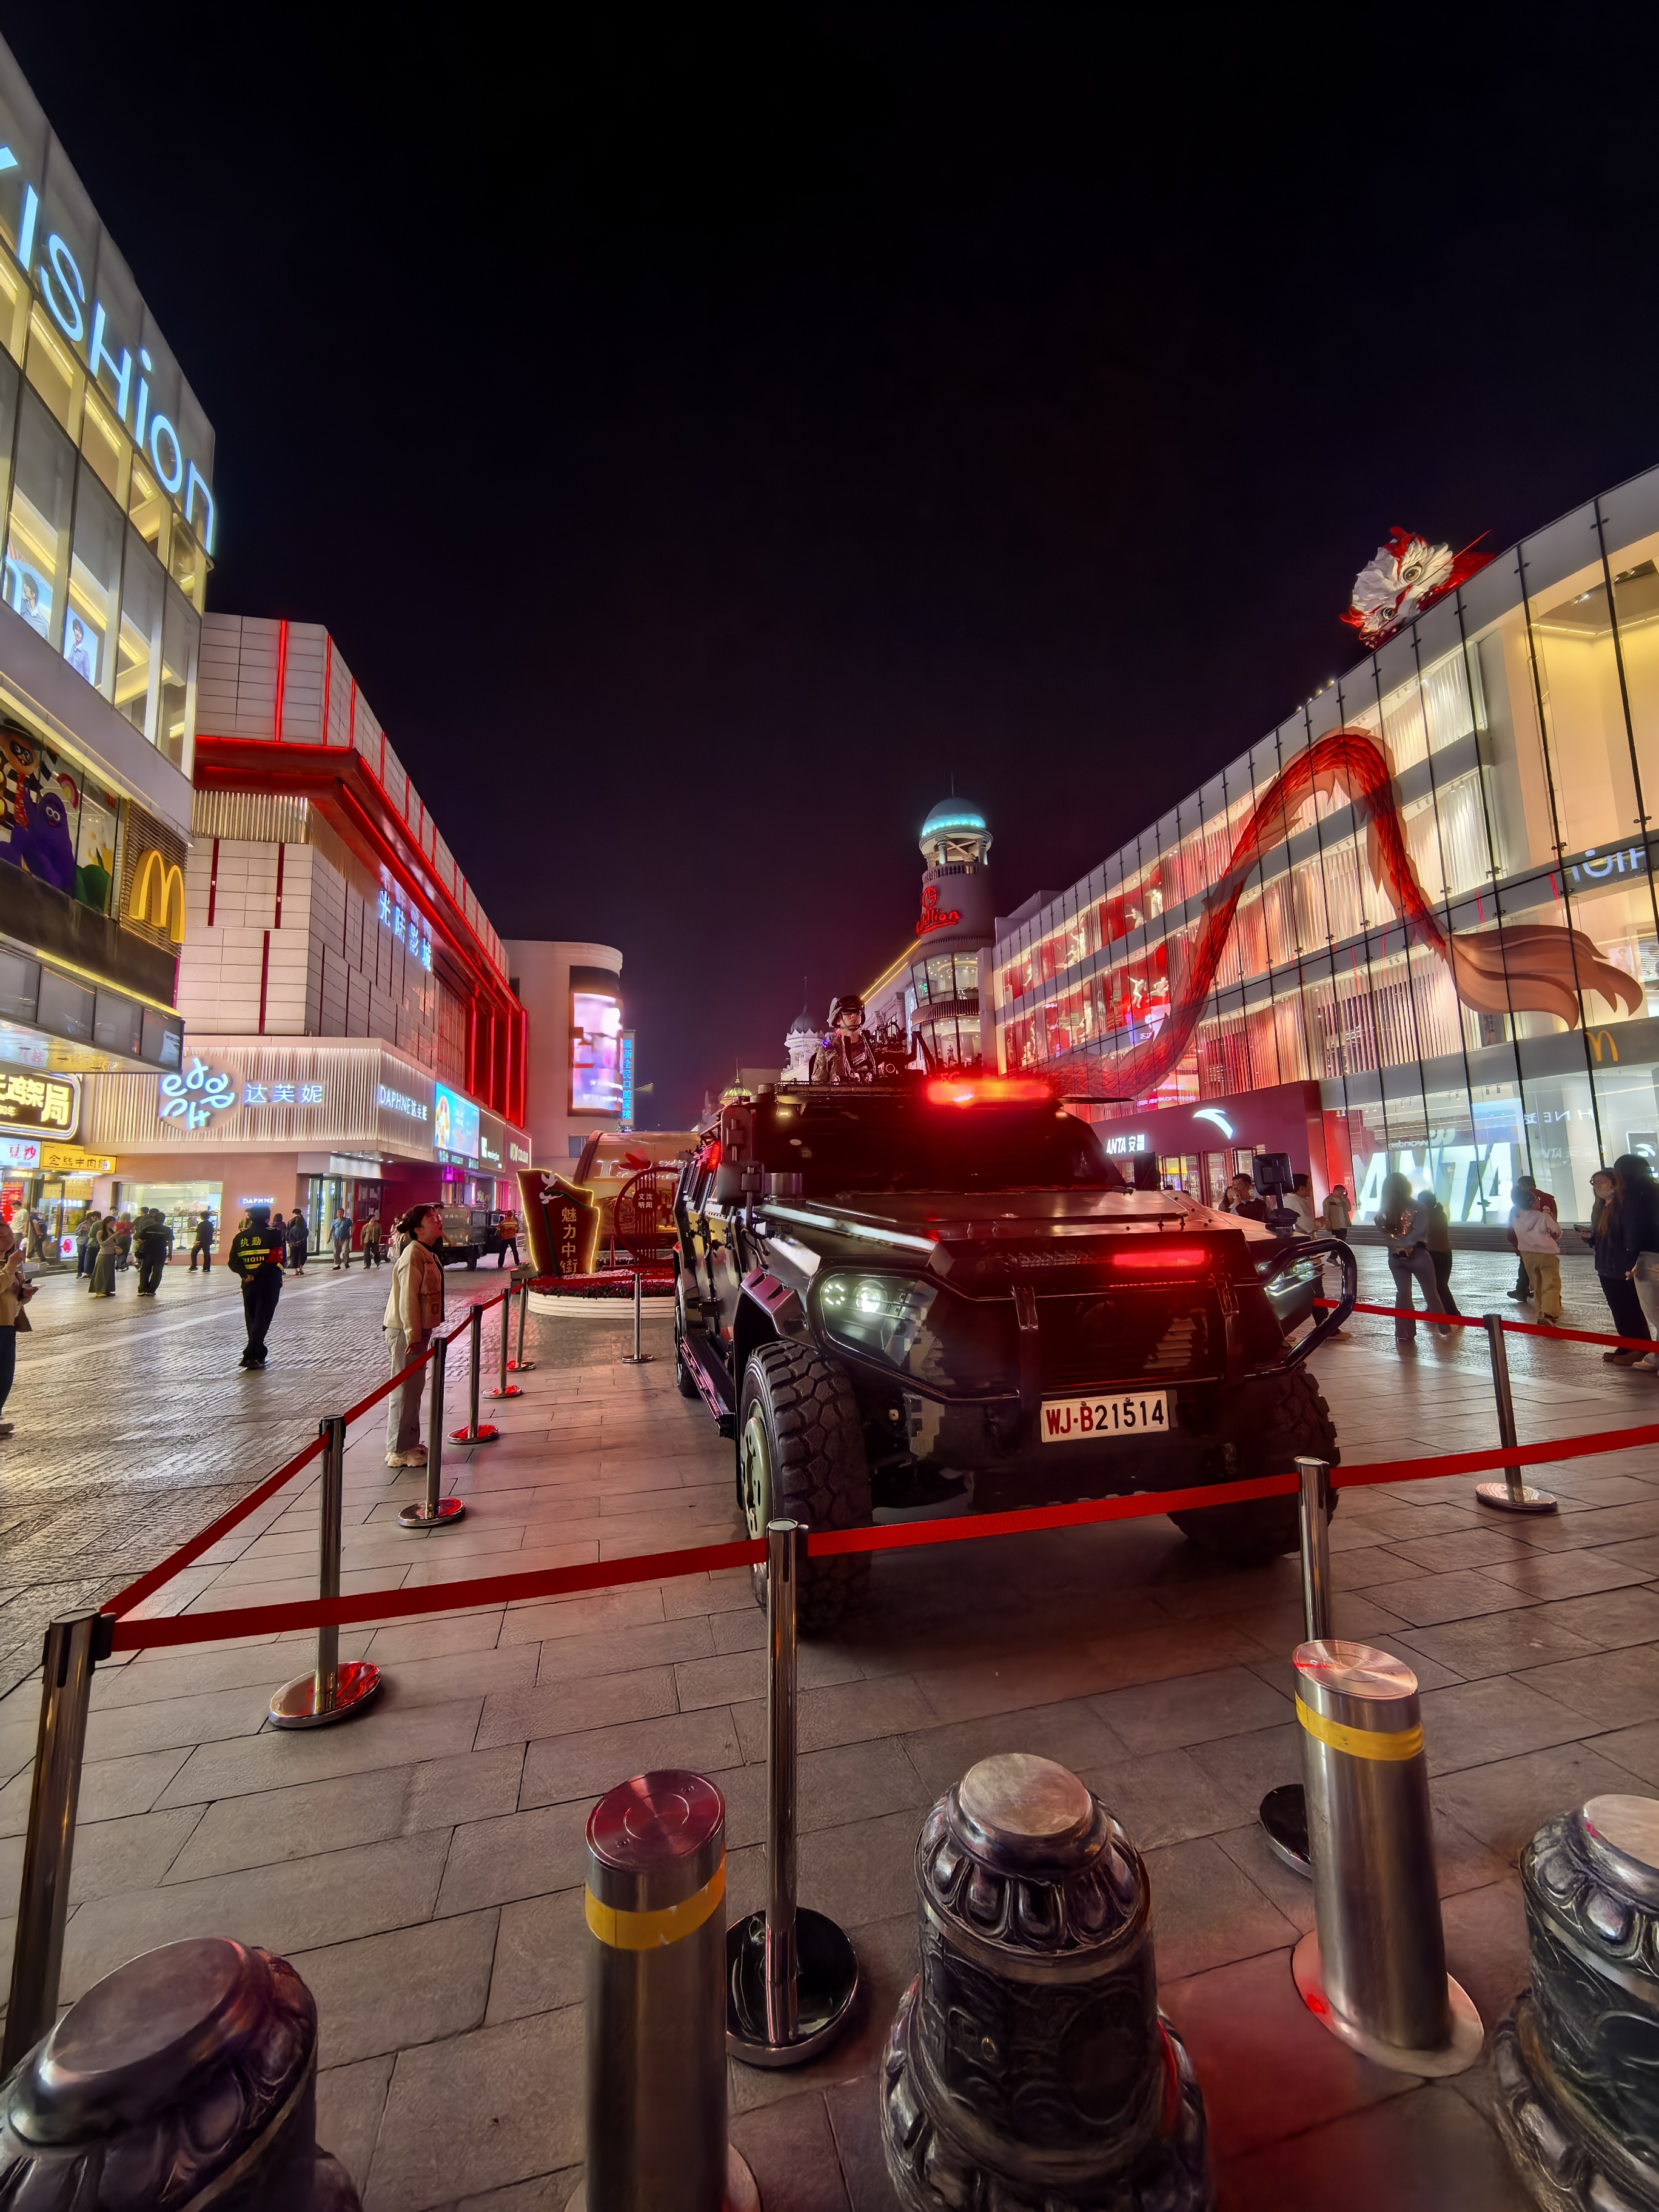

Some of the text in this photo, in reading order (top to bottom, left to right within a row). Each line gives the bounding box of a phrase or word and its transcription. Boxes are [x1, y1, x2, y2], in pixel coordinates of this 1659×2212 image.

[0, 146, 216, 557] ISHion
[245, 1084, 323, 1103] 达芙妮
[380, 1085, 411, 1114] DAPHNE
[1106, 1137, 1126, 1155] ANTA
[1356, 1142, 1513, 1223] ANTA
[638, 1193, 645, 1208] 文明
[240, 1236, 261, 1247] 执勤
[560, 1207, 577, 1273] 魅力中街
